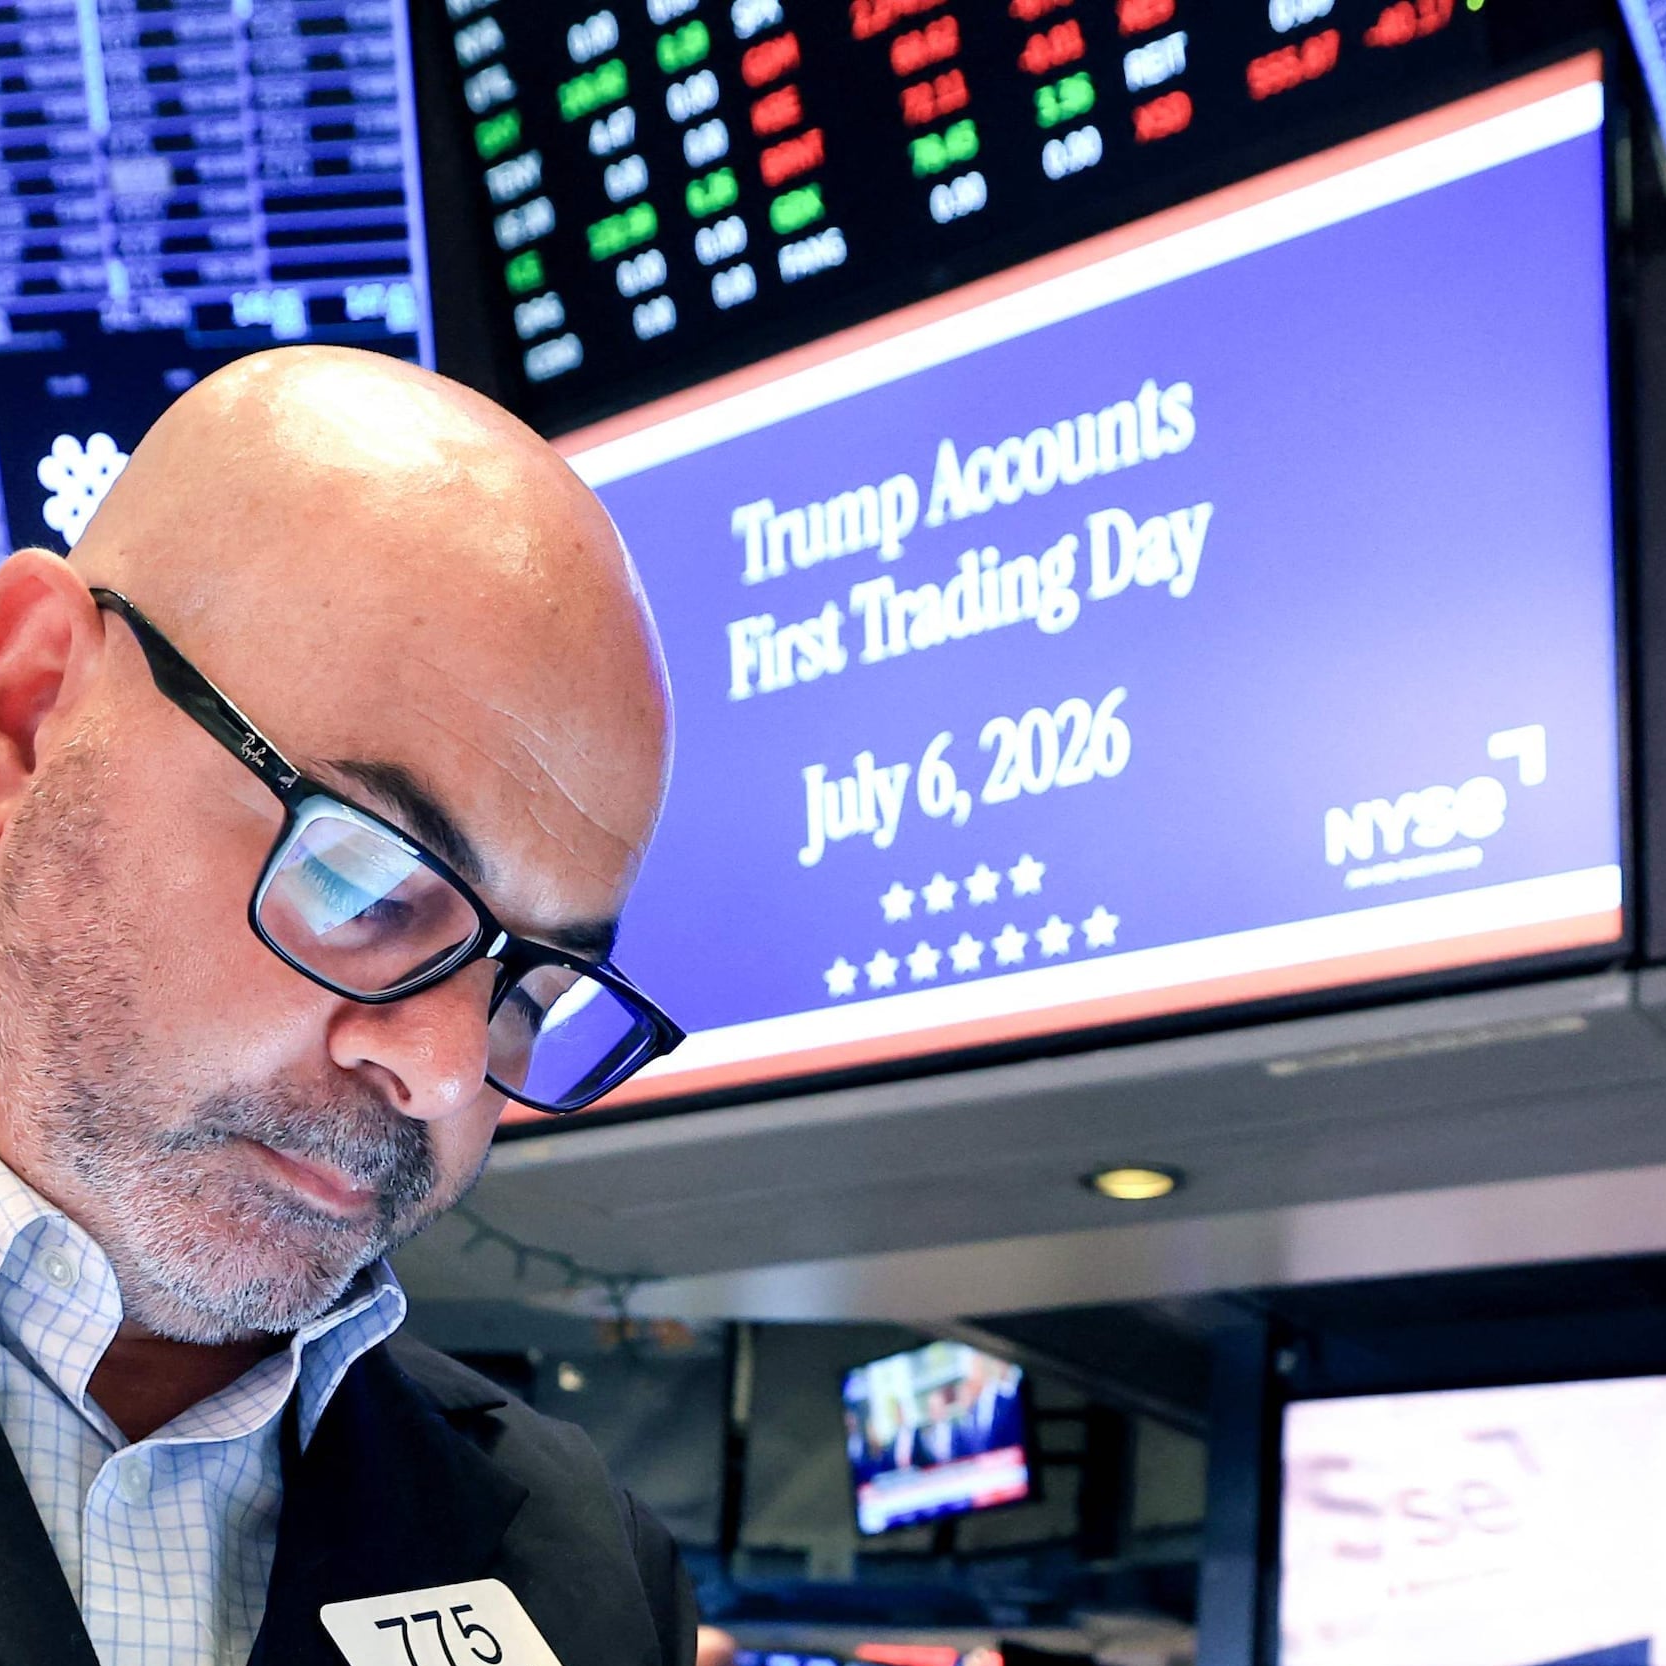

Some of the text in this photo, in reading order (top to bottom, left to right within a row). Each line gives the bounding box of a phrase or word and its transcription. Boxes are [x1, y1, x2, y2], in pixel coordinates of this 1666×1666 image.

[731, 378, 1197, 586] Trump Accounts
[726, 501, 1214, 702] First Trading Day
[797, 685, 1132, 867] July 6, 2026
